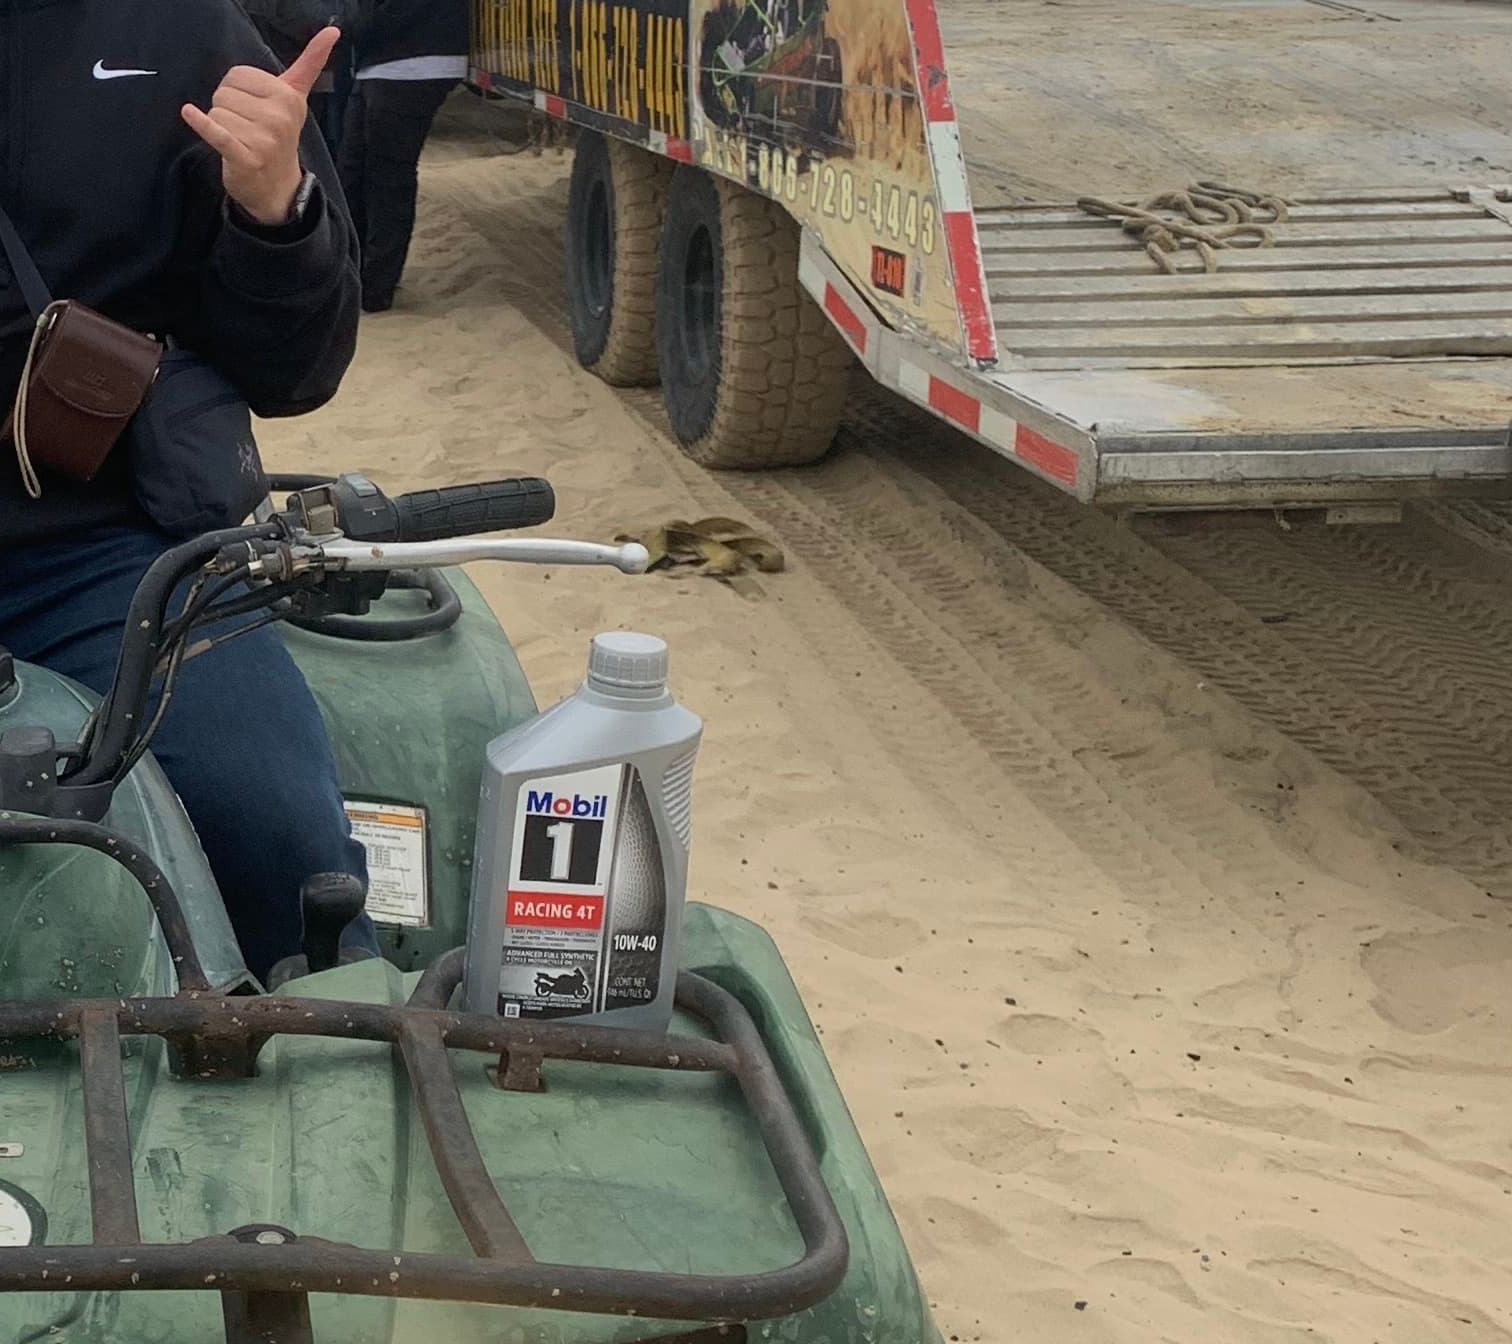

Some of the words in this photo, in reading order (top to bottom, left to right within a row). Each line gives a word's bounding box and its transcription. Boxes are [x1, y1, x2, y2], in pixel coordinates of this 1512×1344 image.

[526, 790, 608, 818] Mobil
[546, 820, 576, 881] 1
[513, 901, 574, 920] RACING
[576, 904, 596, 921] 4T
[613, 933, 658, 953] 10W-40
